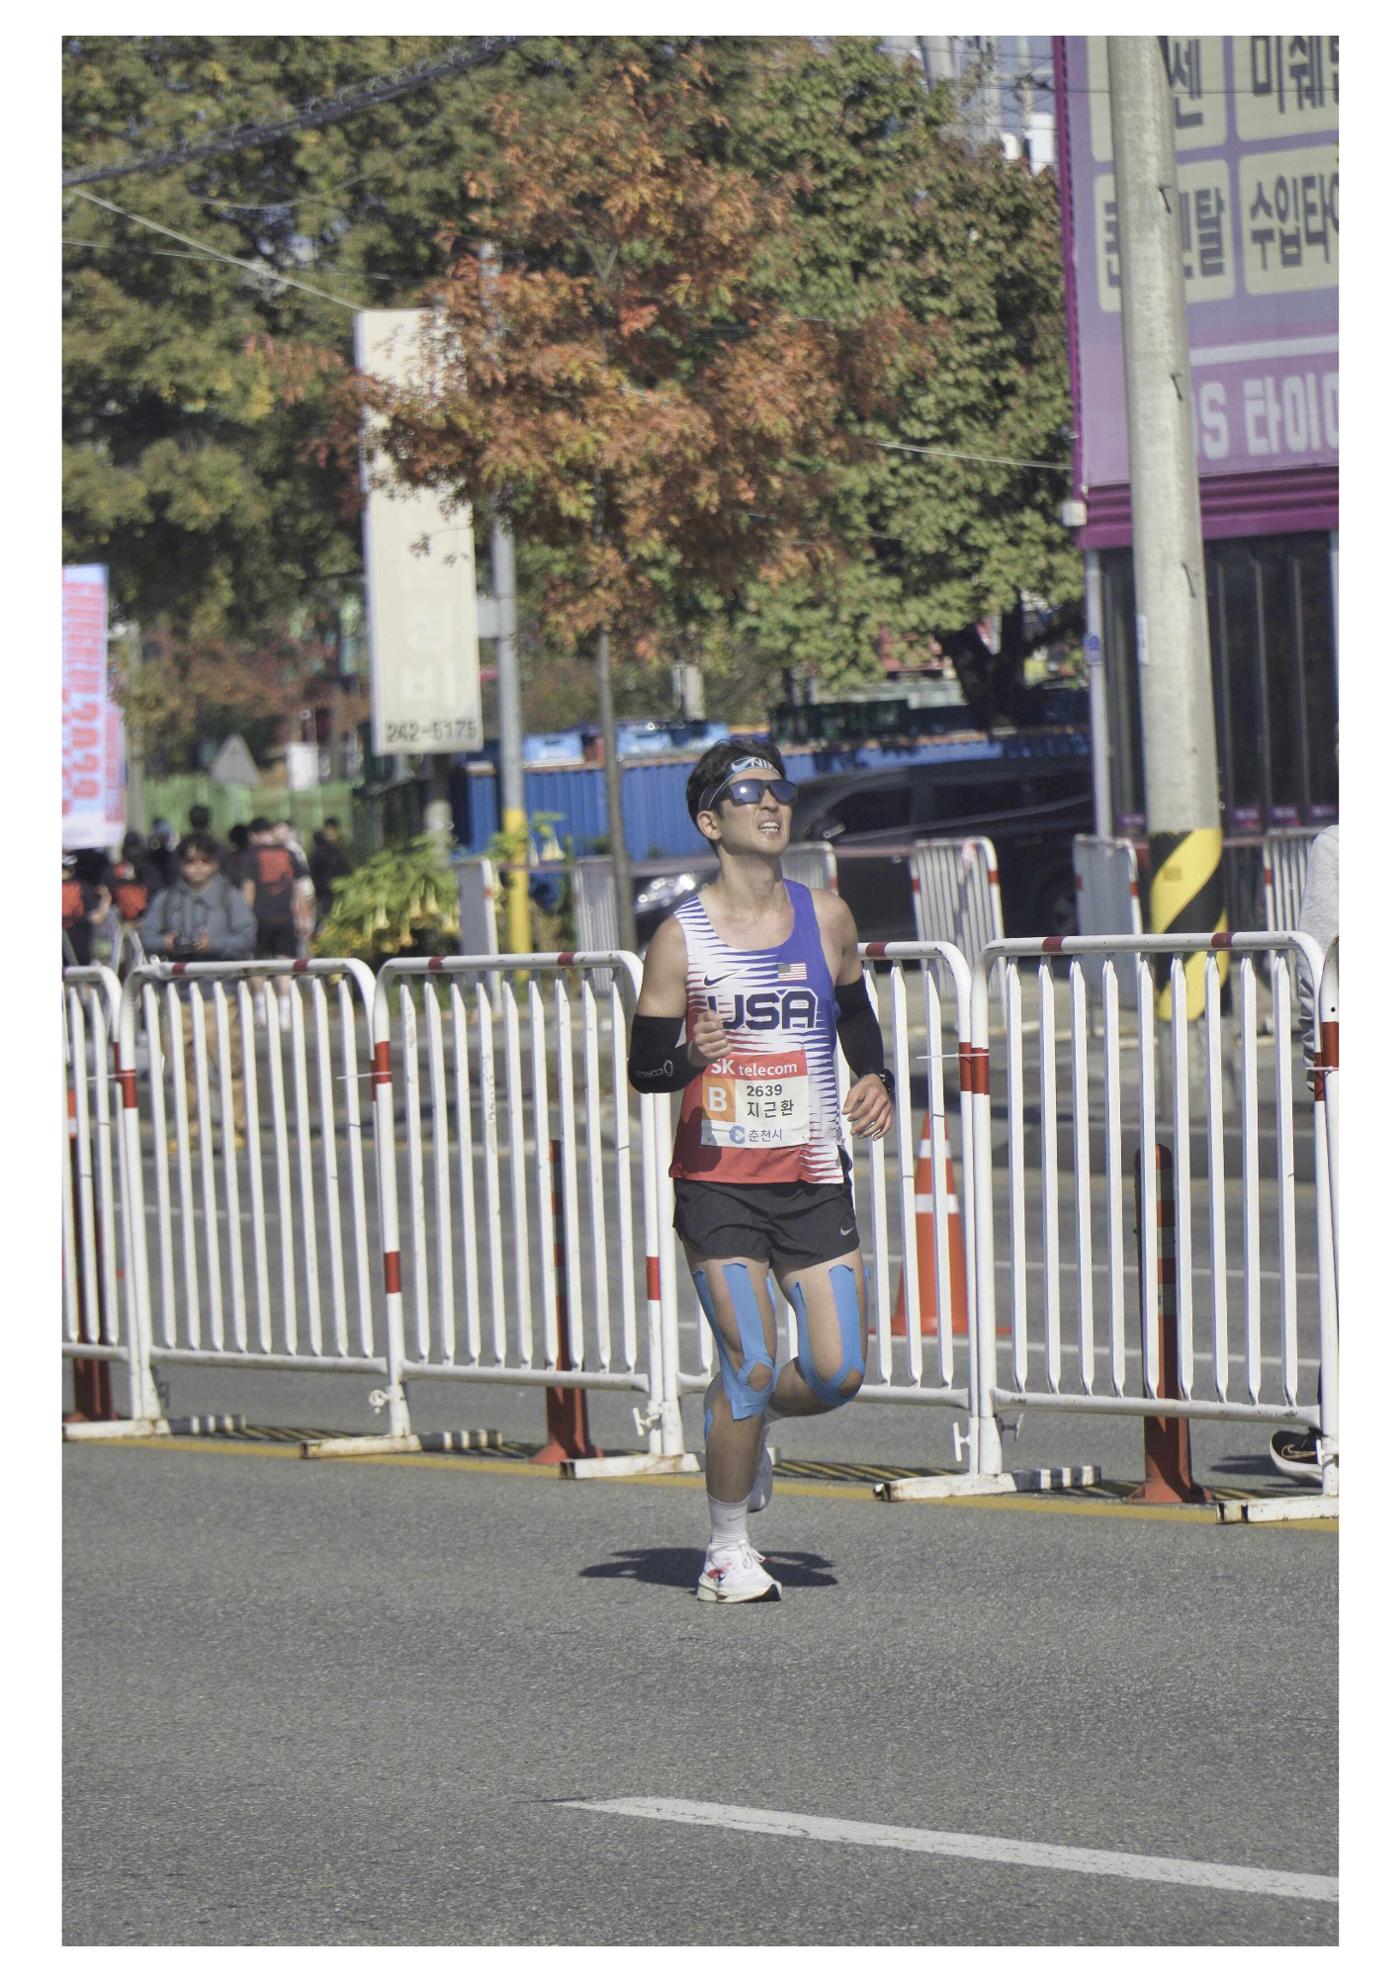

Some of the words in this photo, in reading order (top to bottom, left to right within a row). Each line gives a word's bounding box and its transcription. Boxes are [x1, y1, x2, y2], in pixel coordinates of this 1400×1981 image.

[707, 990, 815, 1030] USA
[711, 1059, 736, 1075] SK
[738, 1063, 798, 1077] telecom
[708, 1086, 728, 1112] B
[746, 1084, 783, 1097] 2639
[748, 1129, 783, 1143] 춘천시
